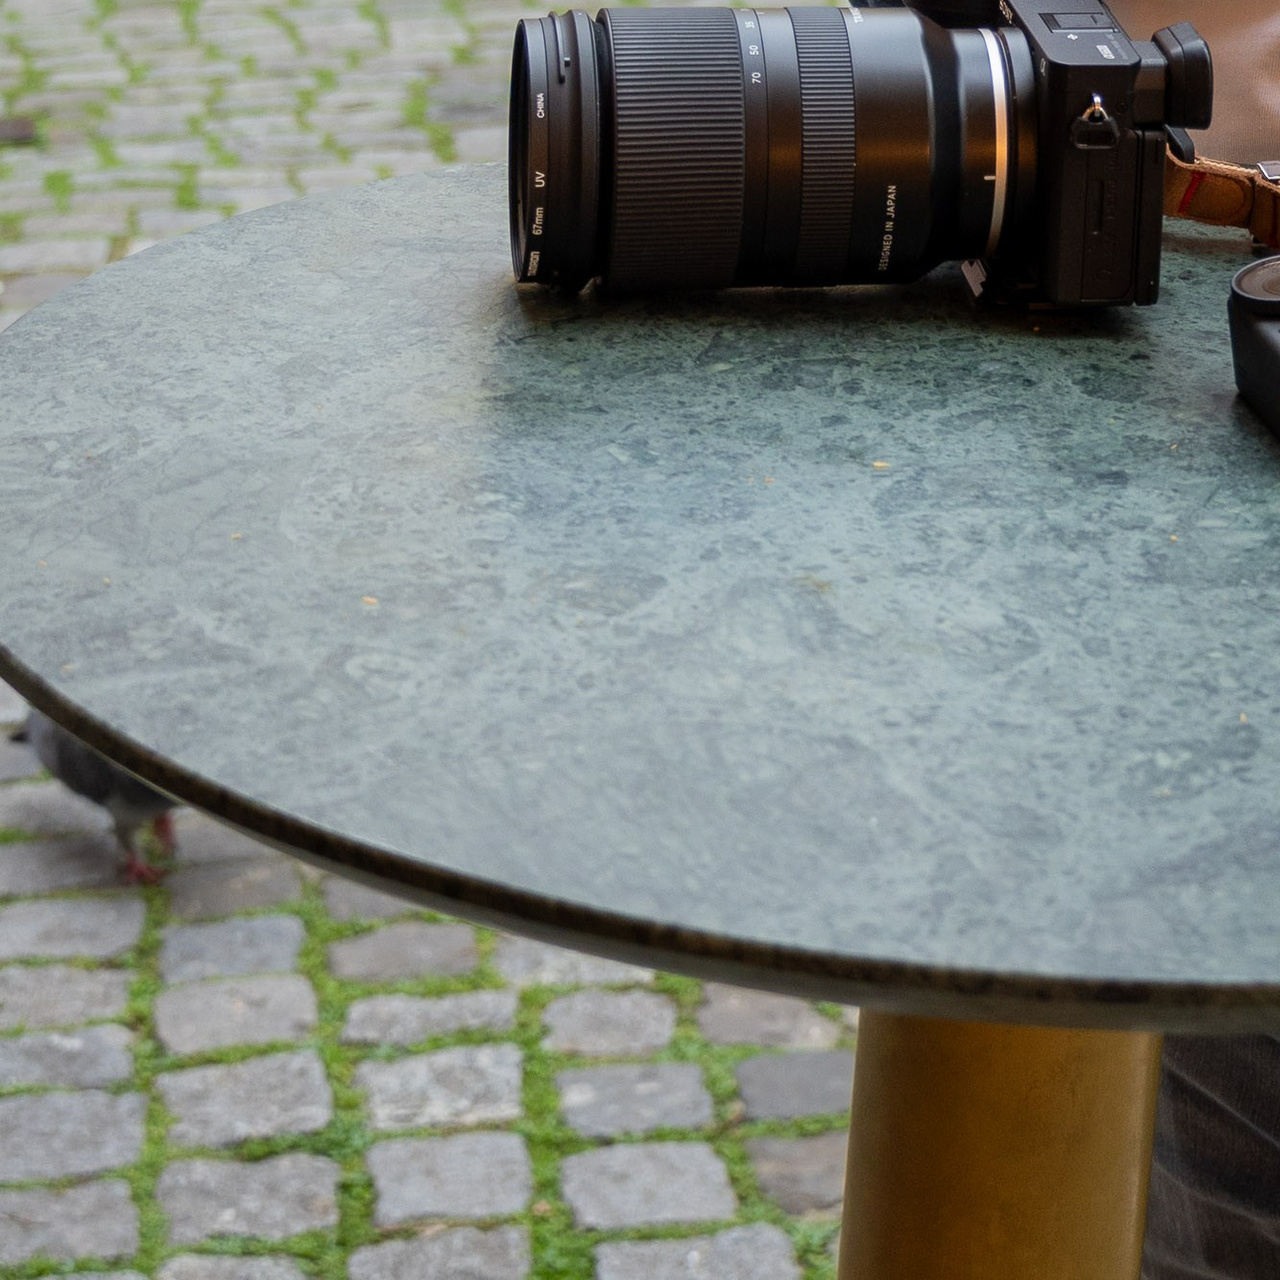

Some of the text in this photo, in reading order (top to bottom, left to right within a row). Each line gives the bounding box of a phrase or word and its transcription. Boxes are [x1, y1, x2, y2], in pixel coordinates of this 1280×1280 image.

[745, 21, 755, 29] 35
[749, 45, 759, 56] 50
[752, 72, 762, 85] 70
[537, 93, 545, 119] CHINA
[535, 171, 546, 188] UV
[532, 207, 544, 236] 67mm
[878, 185, 897, 271] DESIGNED IN JAPAN
